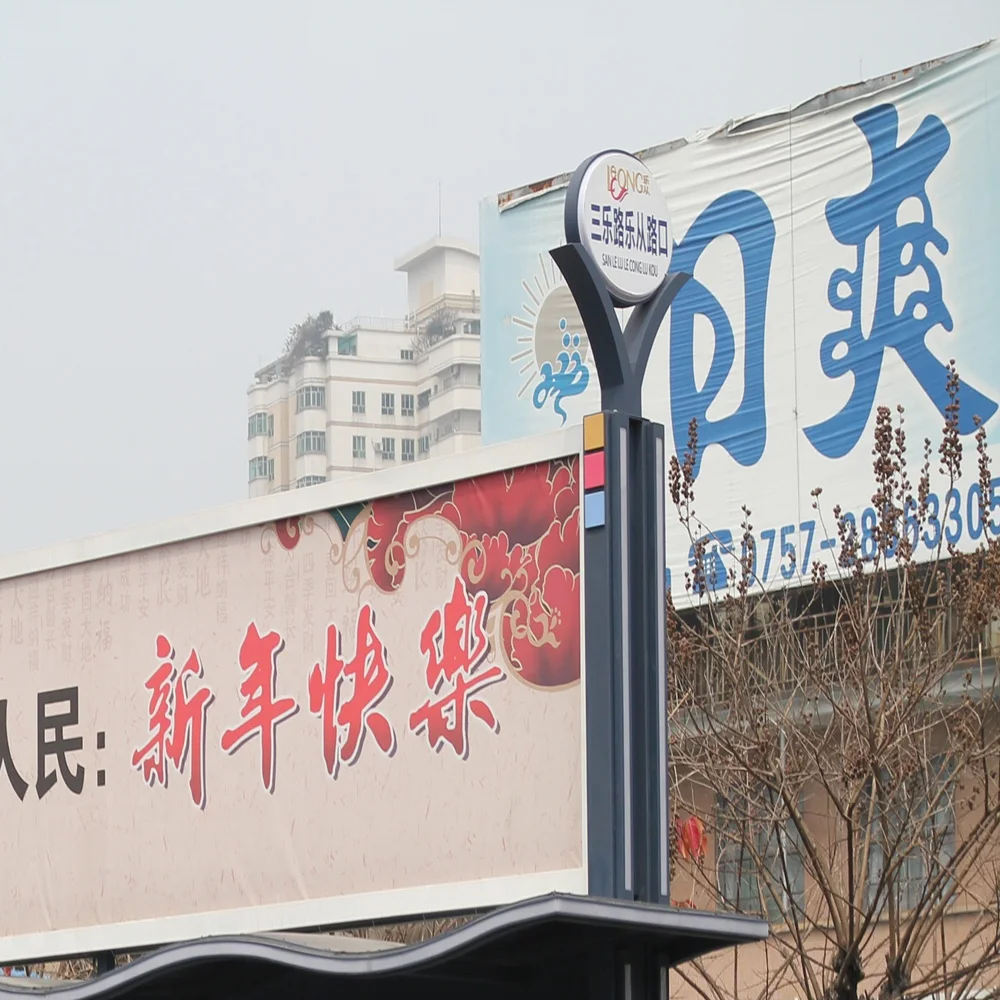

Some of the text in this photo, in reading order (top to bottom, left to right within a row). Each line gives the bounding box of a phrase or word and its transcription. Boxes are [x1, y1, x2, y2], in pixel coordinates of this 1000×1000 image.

[590, 203, 669, 258] 三乐路乐从路口
[602, 253, 612, 267] SAN
[629, 259, 642, 274] CONG
